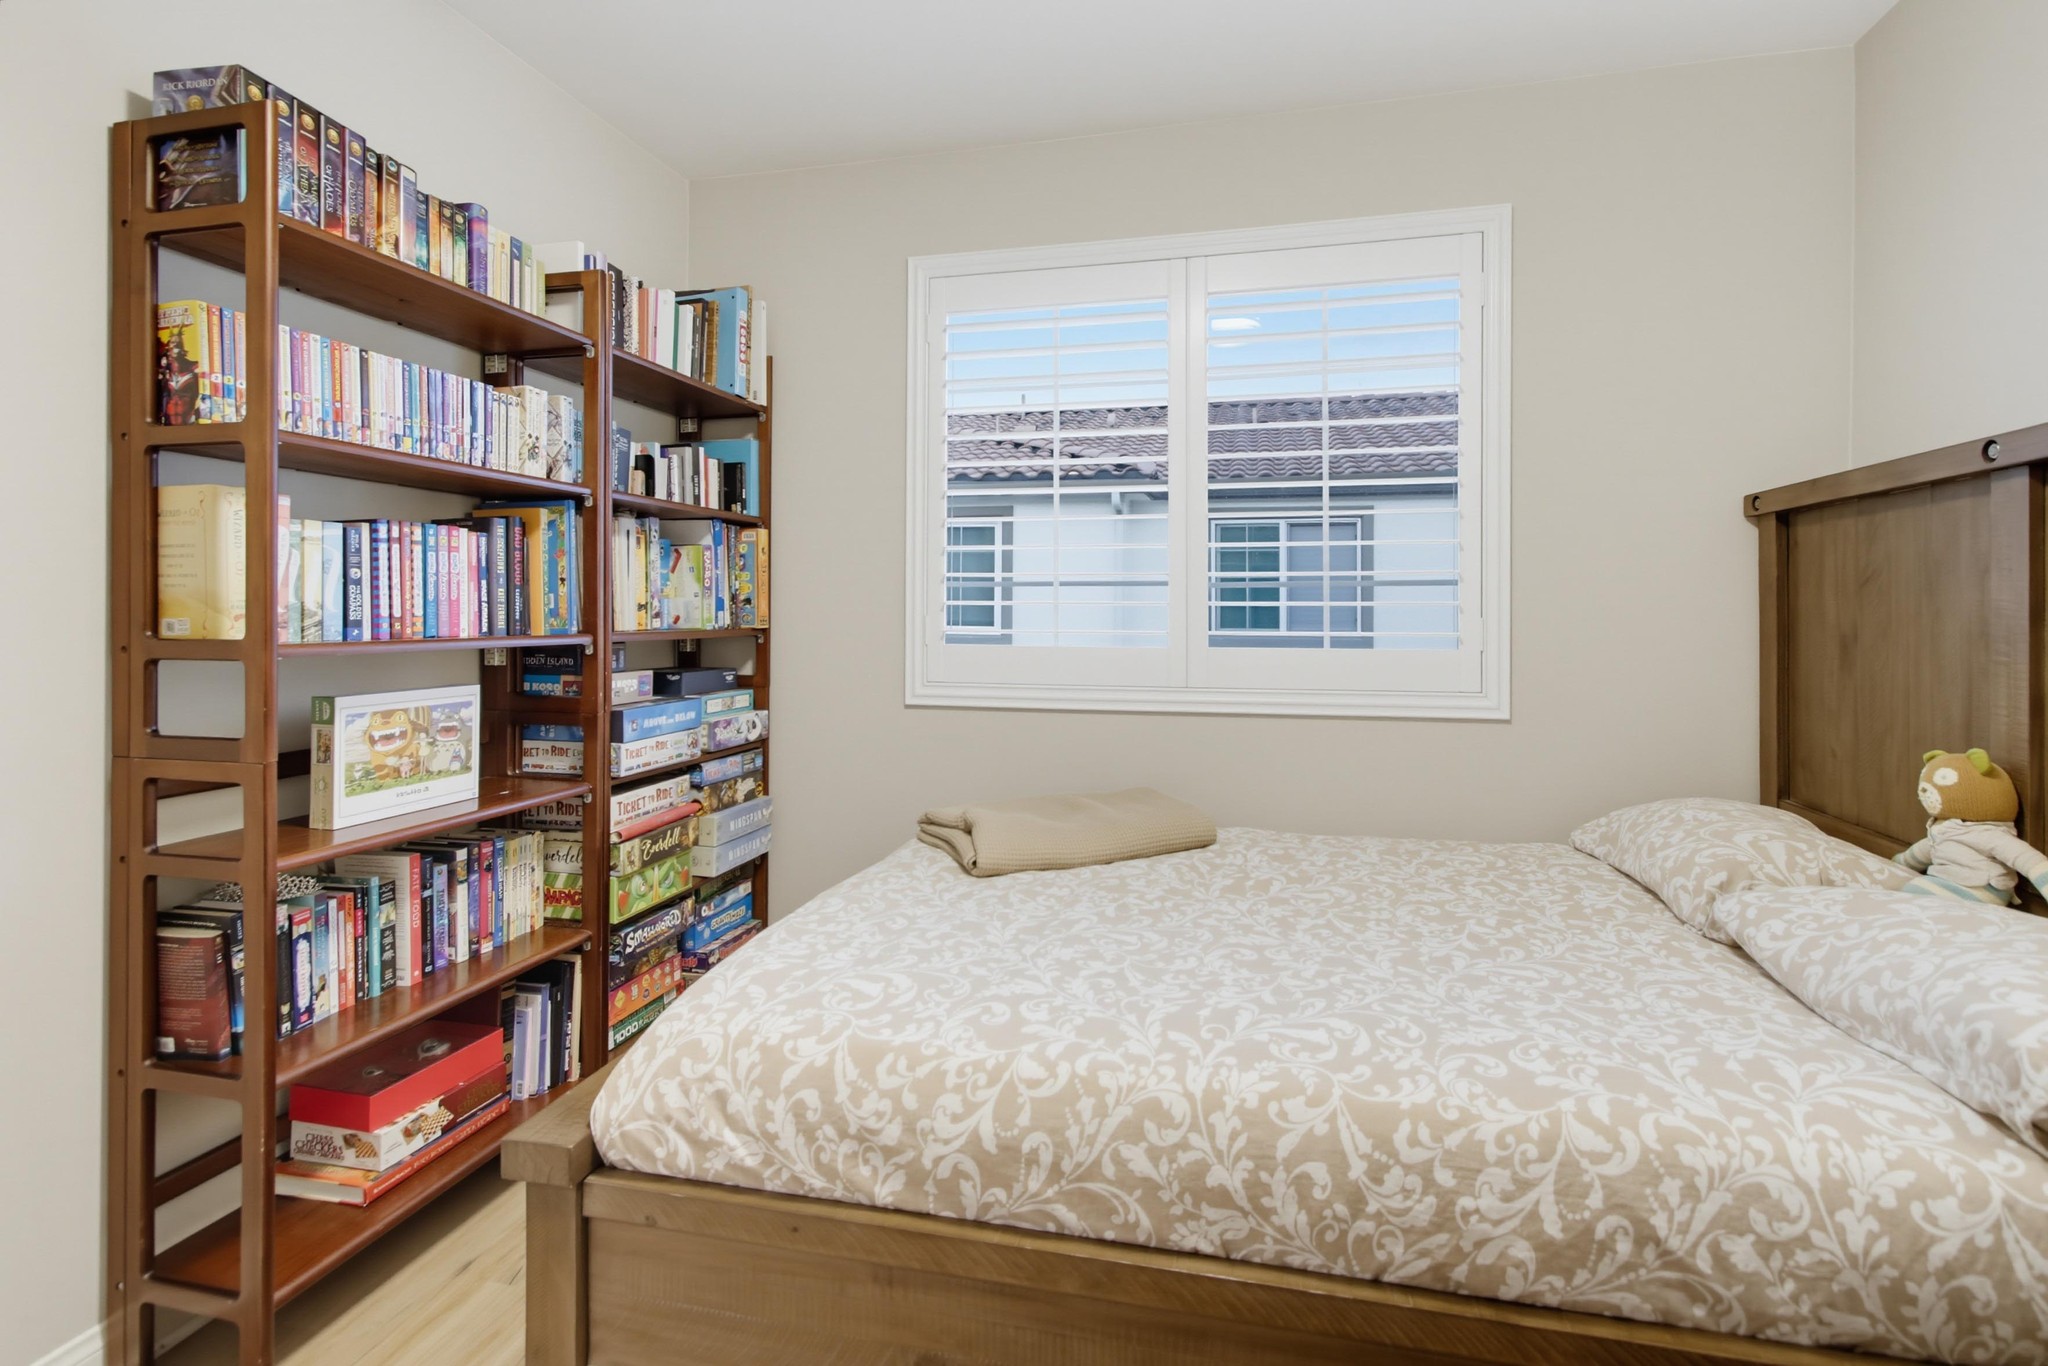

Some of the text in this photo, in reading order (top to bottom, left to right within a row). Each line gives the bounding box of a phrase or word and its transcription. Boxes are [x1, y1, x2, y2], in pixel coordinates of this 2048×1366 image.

[162, 76, 228, 91] RICK RIORDAN
[323, 174, 334, 213] HADES
[547, 657, 574, 666] ISLAND
[523, 748, 540, 758] KET
[551, 745, 571, 758] RIDE
[625, 746, 648, 760] TICKET
[544, 805, 554, 815] TO
[556, 801, 582, 817] RIDE
[616, 795, 646, 816] TICKET
[656, 786, 673, 801] RIDE
[730, 810, 762, 832] WINGSPAN
[641, 826, 680, 860] Everdell
[728, 837, 760, 861] WINGSPAN
[544, 845, 582, 865] verdel
[412, 900, 420, 928] FOOD
[614, 1022, 638, 1043] 1000
[295, 1140, 344, 1154] CHECKERS
[306, 1133, 334, 1144] CHESS
